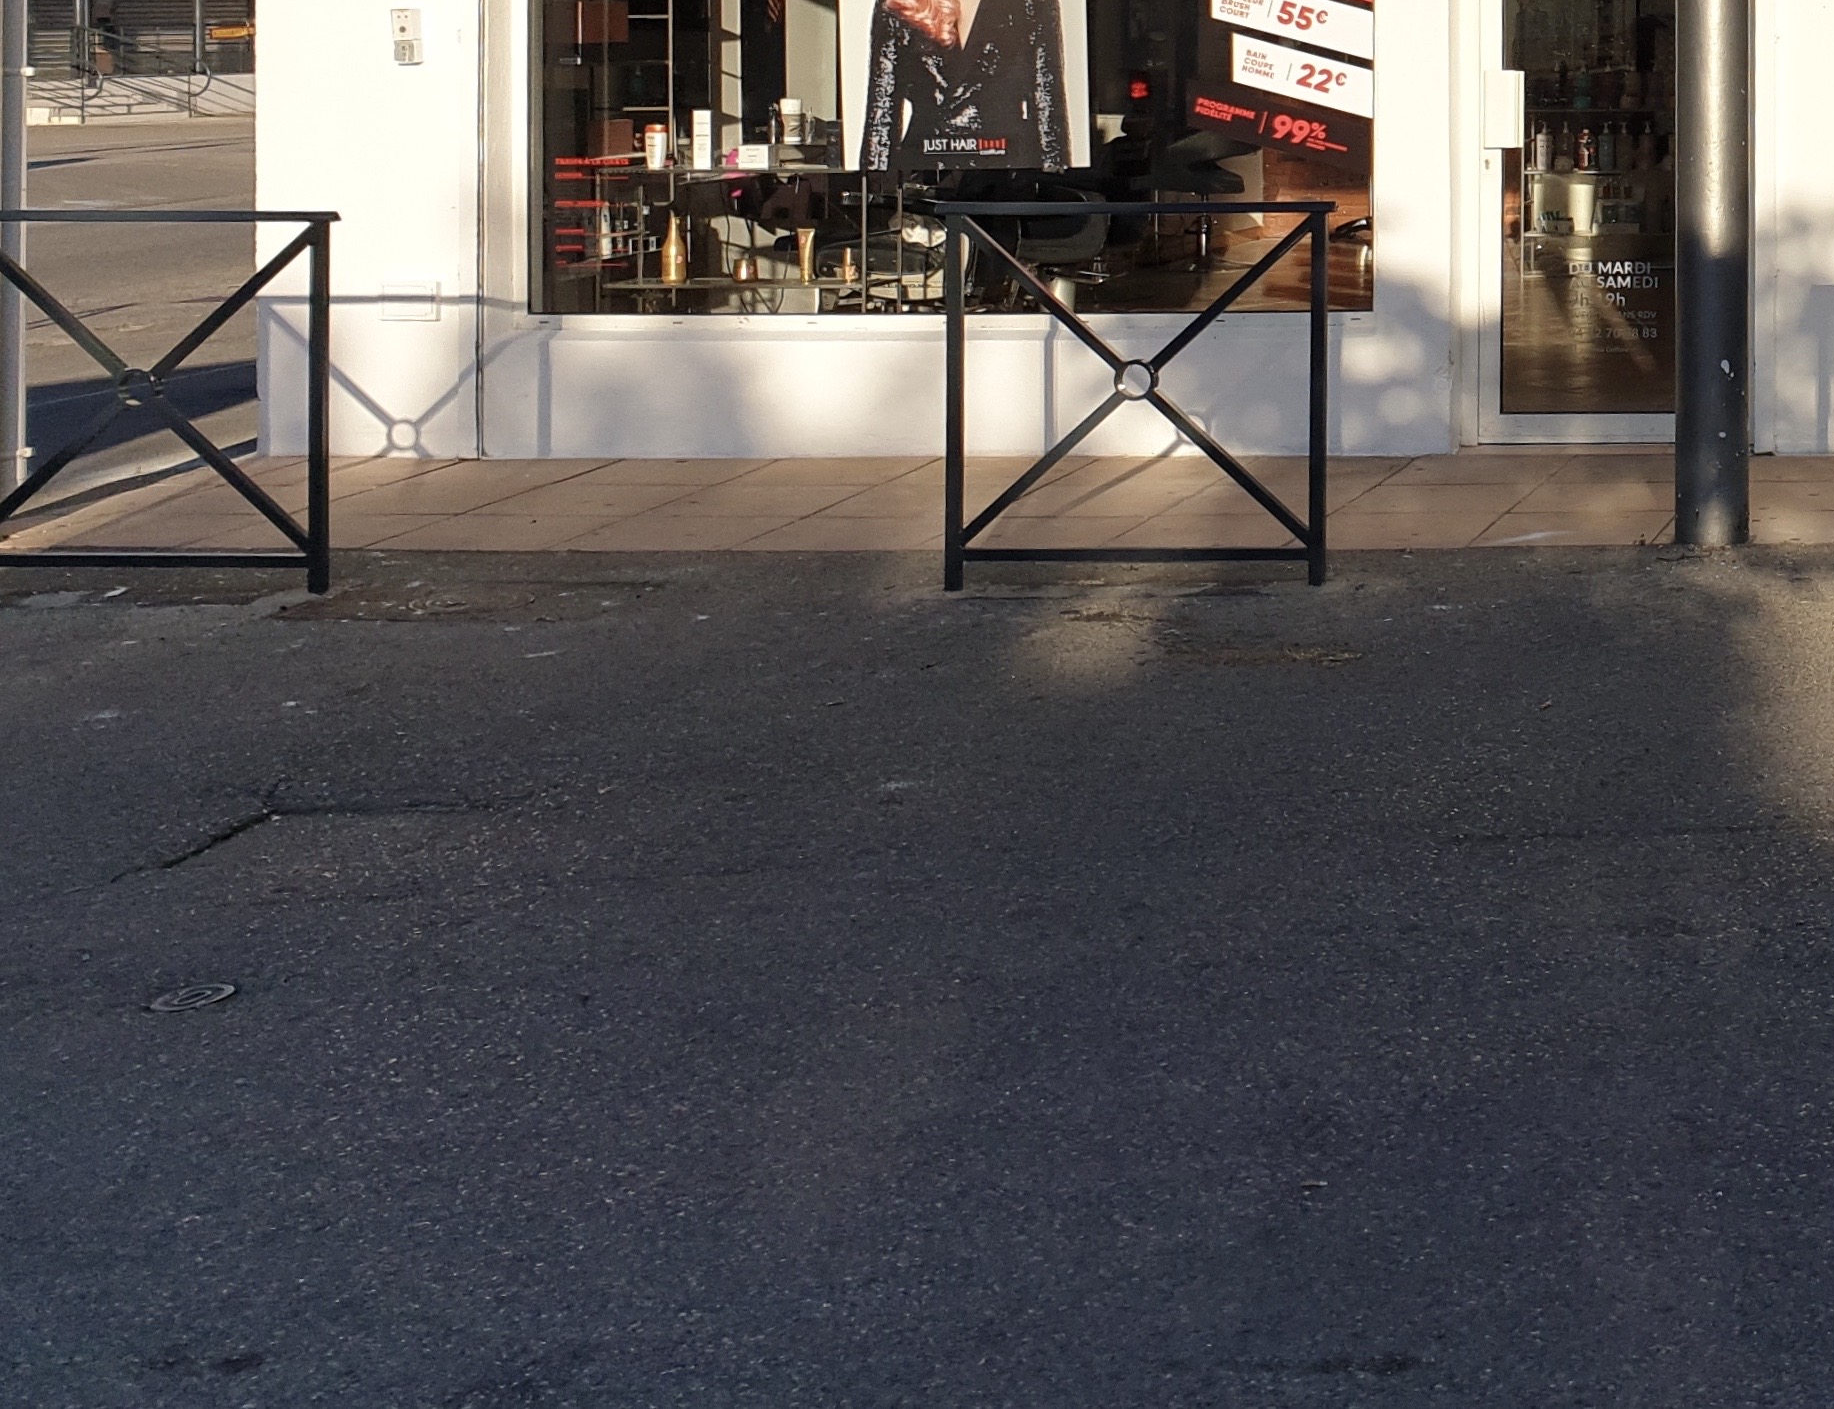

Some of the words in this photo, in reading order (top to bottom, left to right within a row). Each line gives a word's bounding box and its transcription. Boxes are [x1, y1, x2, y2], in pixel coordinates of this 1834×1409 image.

[1219, 6, 1250, 19] COURT
[1276, 0, 1329, 31] 55€
[1246, 49, 1267, 61] BAIN
[1244, 58, 1274, 71] COUPE
[1295, 63, 1348, 94] 22€
[1196, 97, 1256, 120] PROGRAMME
[1272, 114, 1327, 144] 99%
[923, 139, 948, 153] JUST
[951, 139, 977, 151] HAIR
[1569, 262, 1592, 275] DU
[1598, 262, 1650, 275] MARDI
[1597, 276, 1658, 289] SAMEDI
